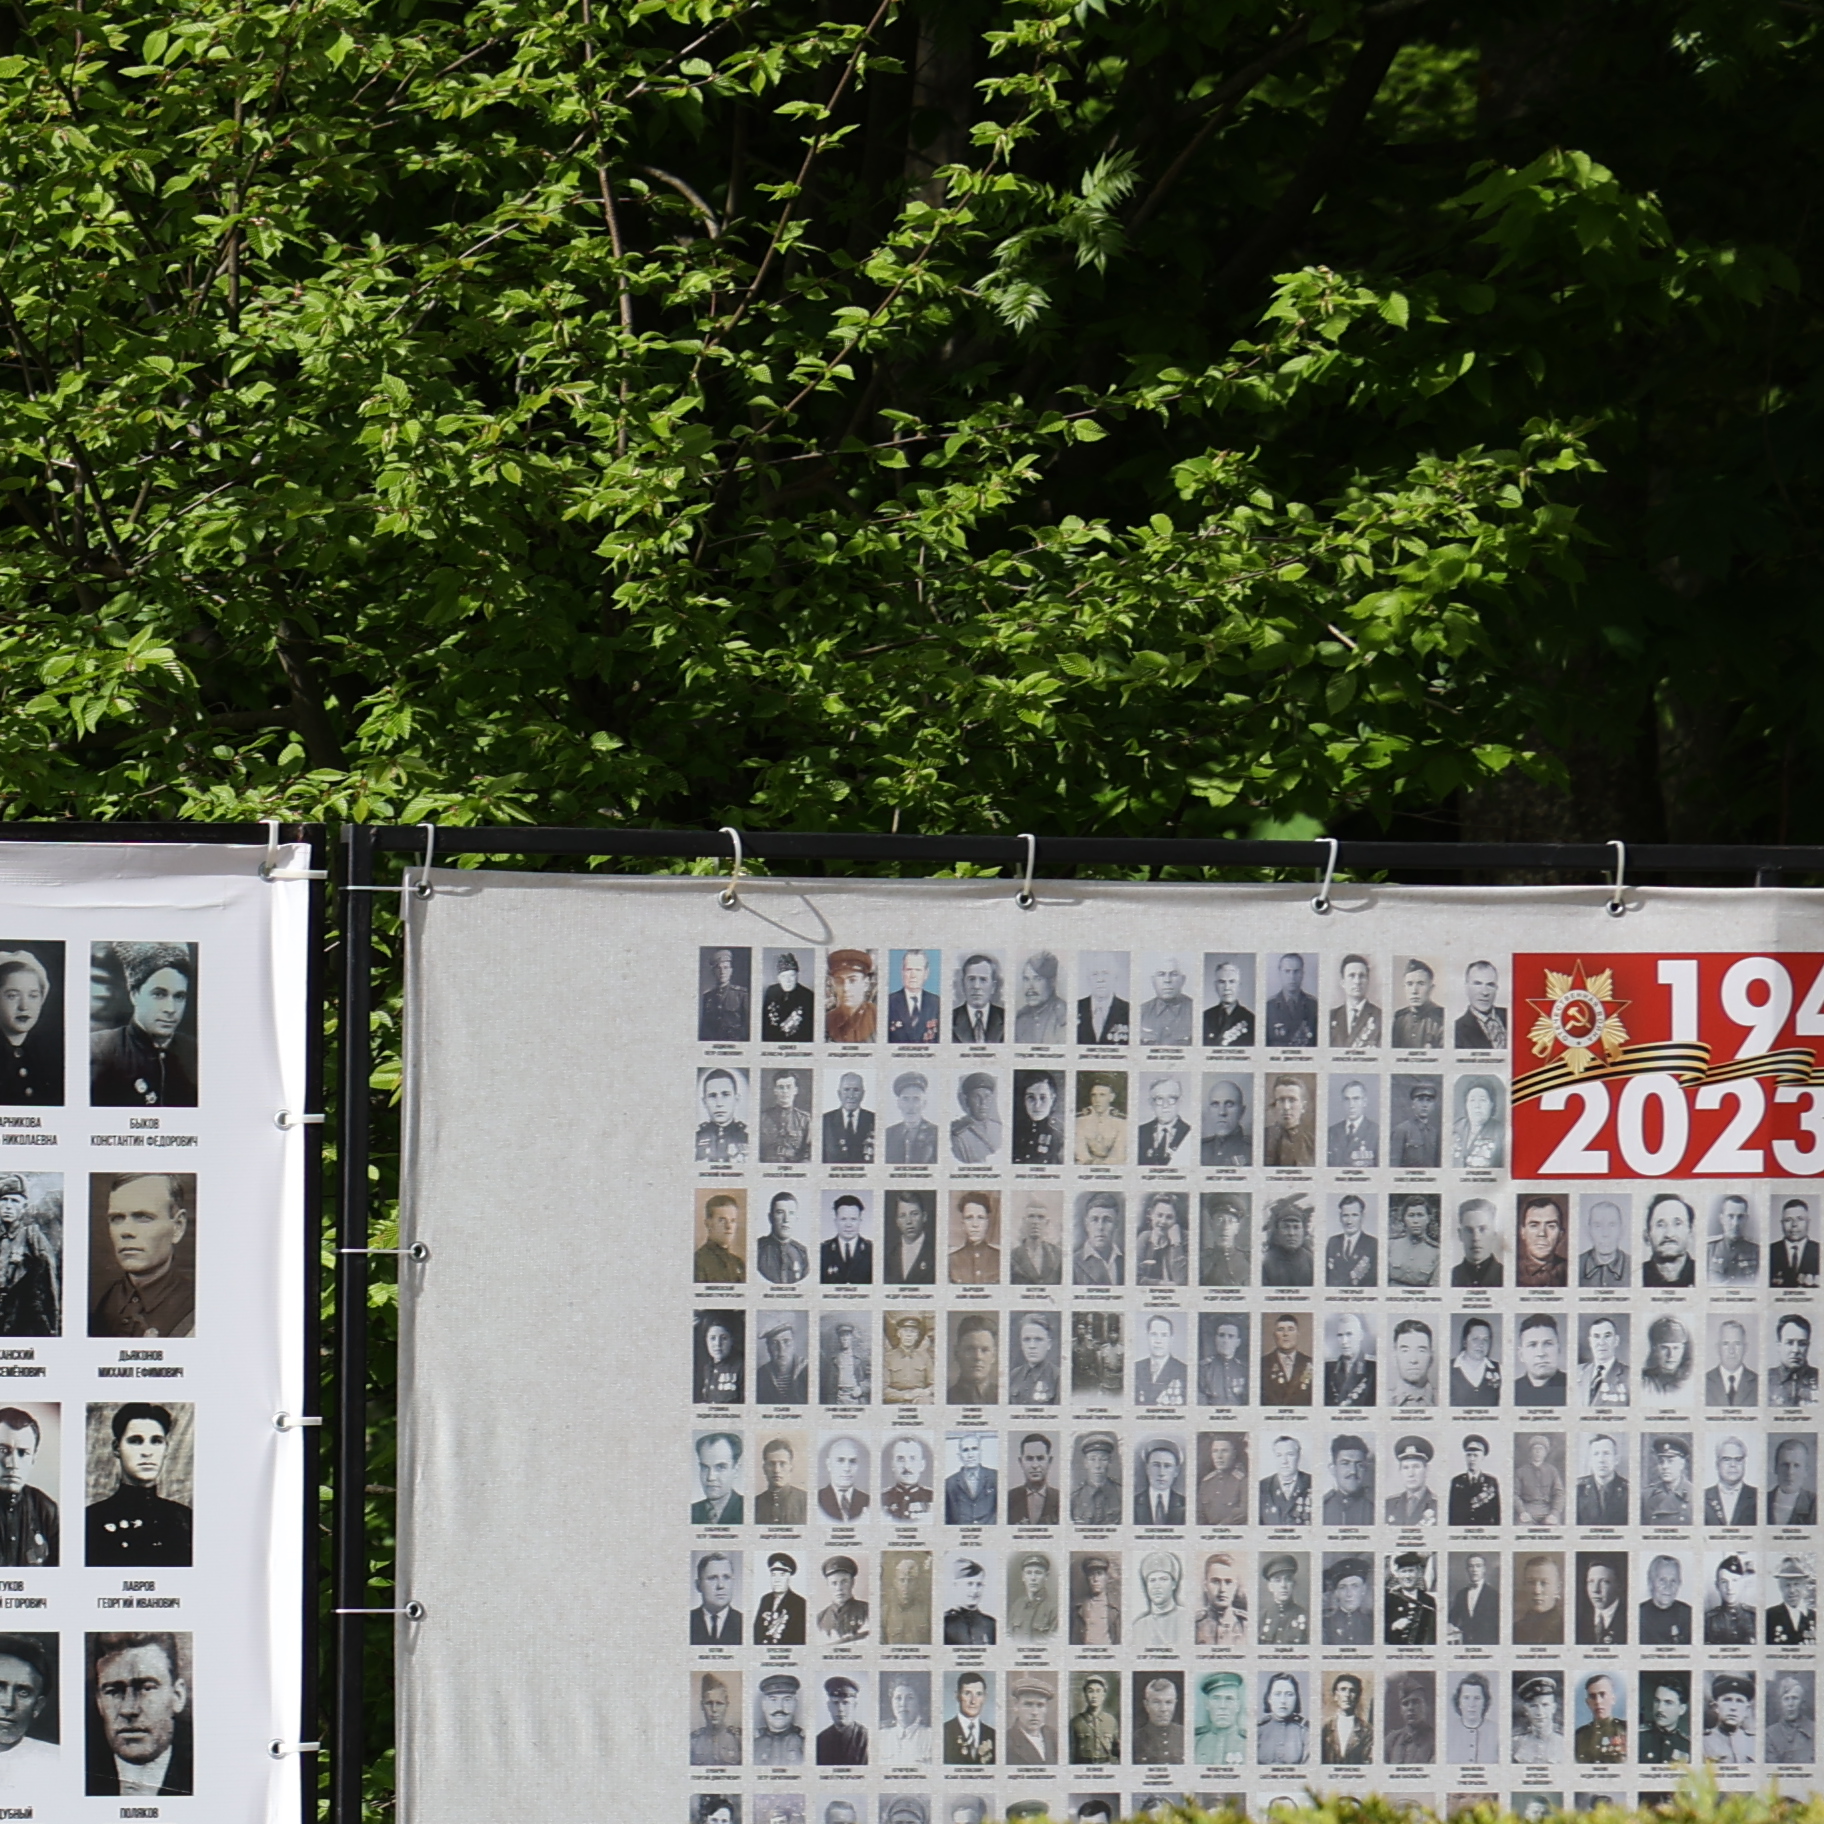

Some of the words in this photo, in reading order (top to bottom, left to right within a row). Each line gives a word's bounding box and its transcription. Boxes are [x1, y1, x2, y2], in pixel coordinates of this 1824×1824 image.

[1537, 1074, 1824, 1177] 2023
[97, 1595, 134, 1609] ГЕОРГИЙ
[135, 1597, 180, 1609] ИВАНОВИЧ
